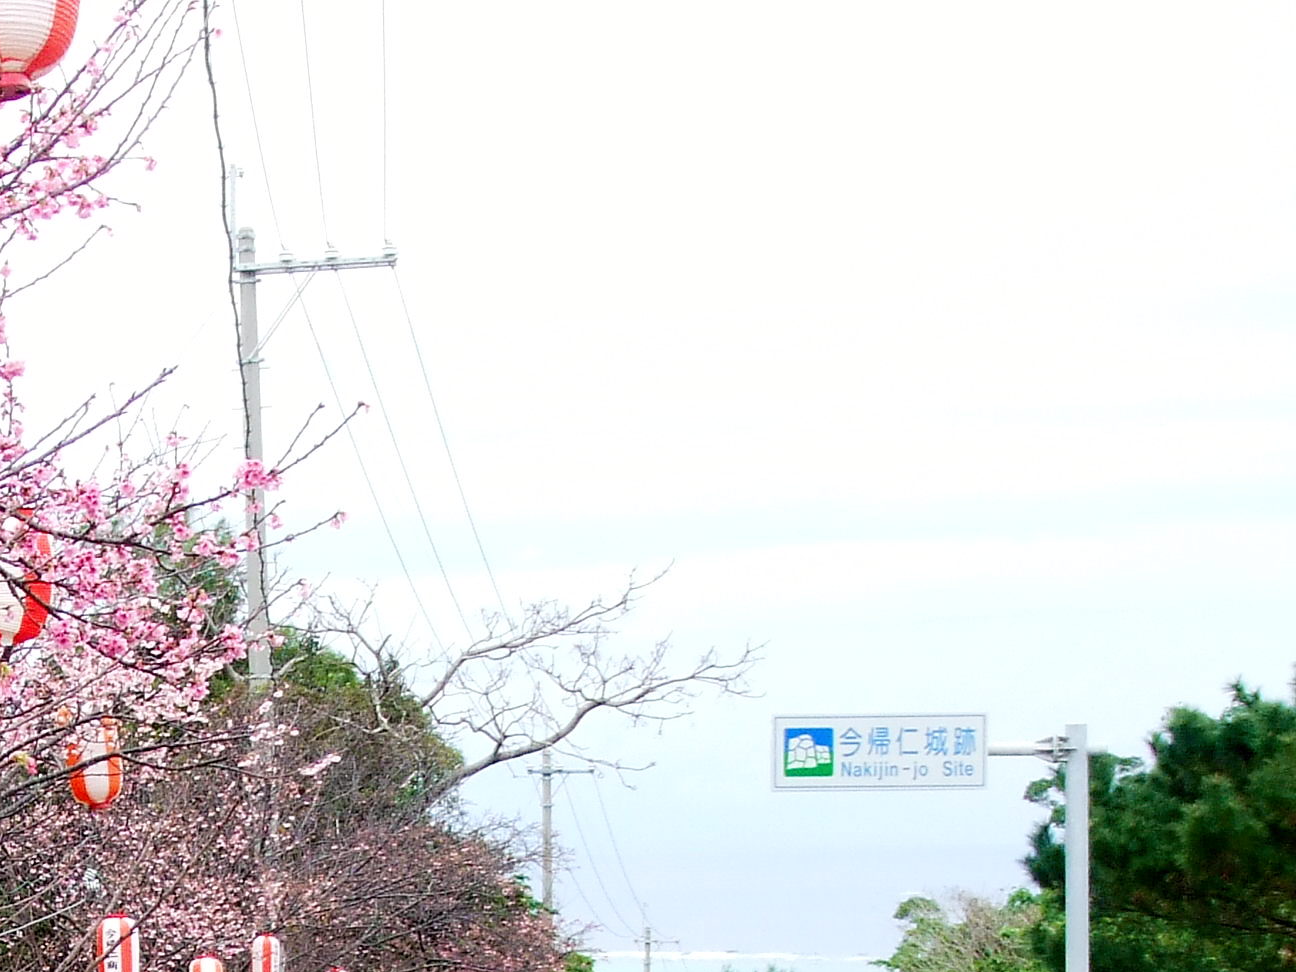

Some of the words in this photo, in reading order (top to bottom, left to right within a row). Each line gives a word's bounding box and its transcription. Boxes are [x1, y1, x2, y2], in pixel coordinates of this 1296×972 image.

[839, 727, 977, 757] 今帰仁城跡
[840, 761, 929, 781] Nakijin-jo
[942, 760, 974, 777] Site
